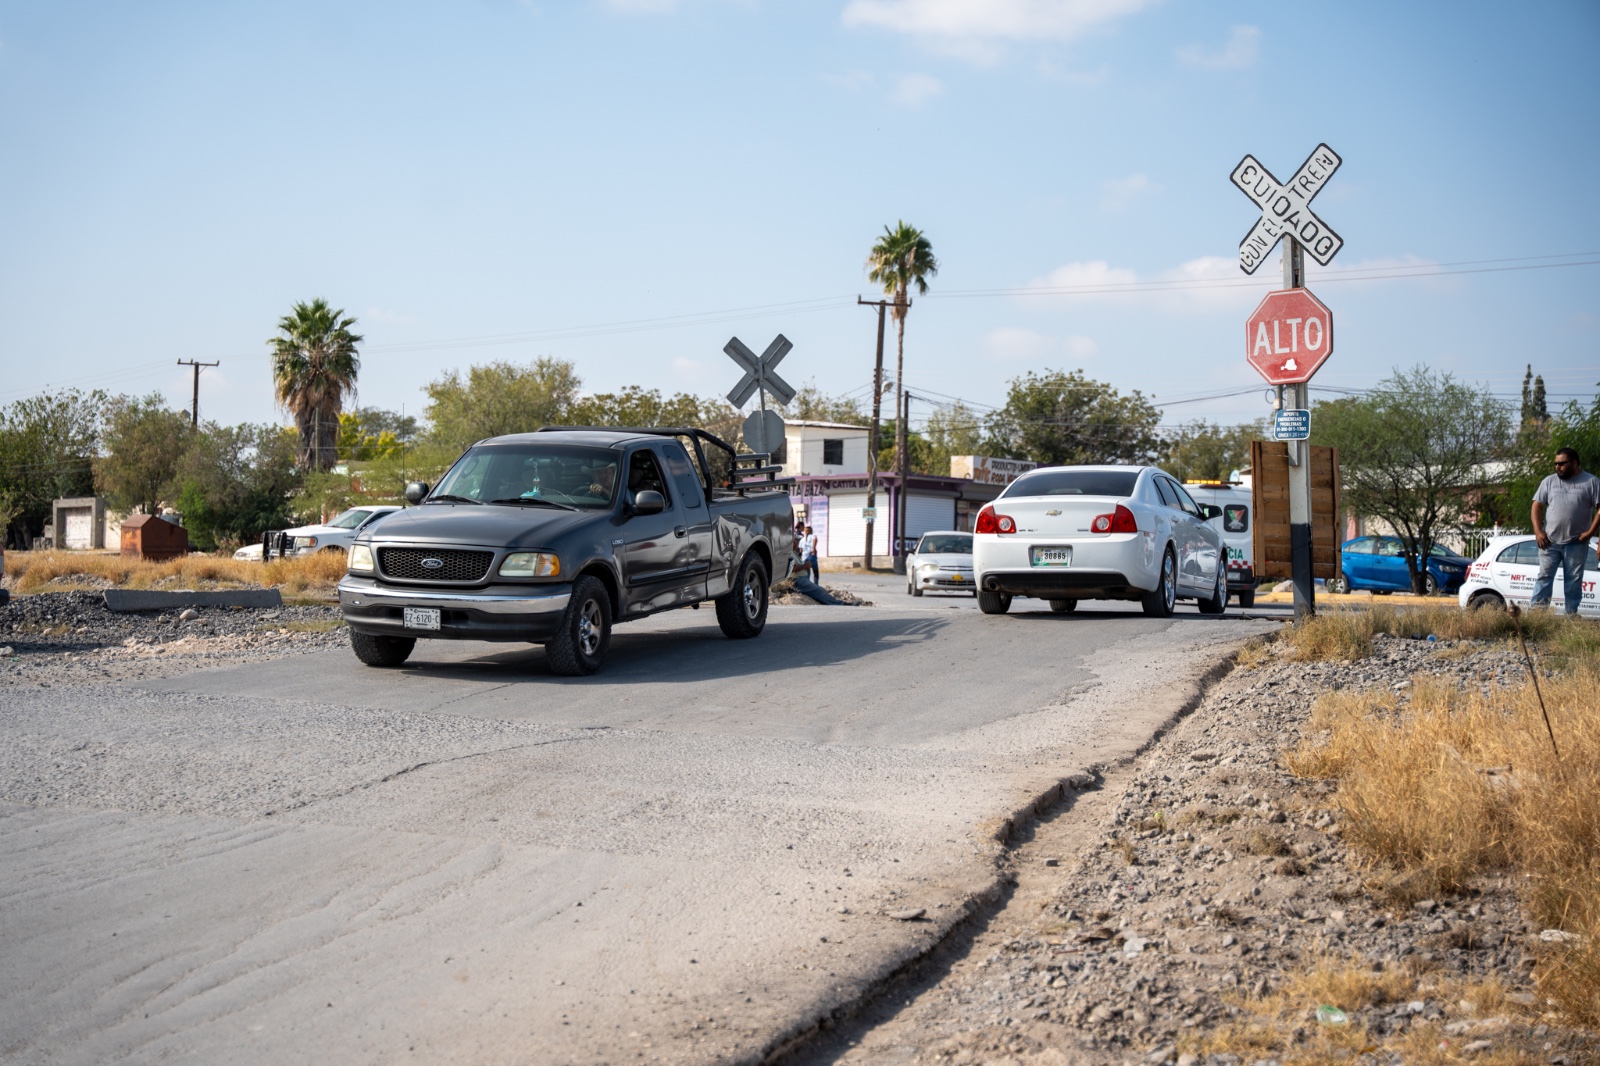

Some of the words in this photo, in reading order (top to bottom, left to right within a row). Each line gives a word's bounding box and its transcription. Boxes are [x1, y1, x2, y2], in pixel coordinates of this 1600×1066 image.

[1288, 153, 1334, 200] TREN
[1240, 165, 1334, 256] CUIDADO
[1253, 316, 1323, 357] ALTO
[1228, 548, 1244, 560] CIA
[1511, 574, 1527, 582] NRT
[1581, 581, 1597, 592] RT
[1582, 592, 1595, 600] ICO
[405, 613, 439, 624] EZ-6120-C
